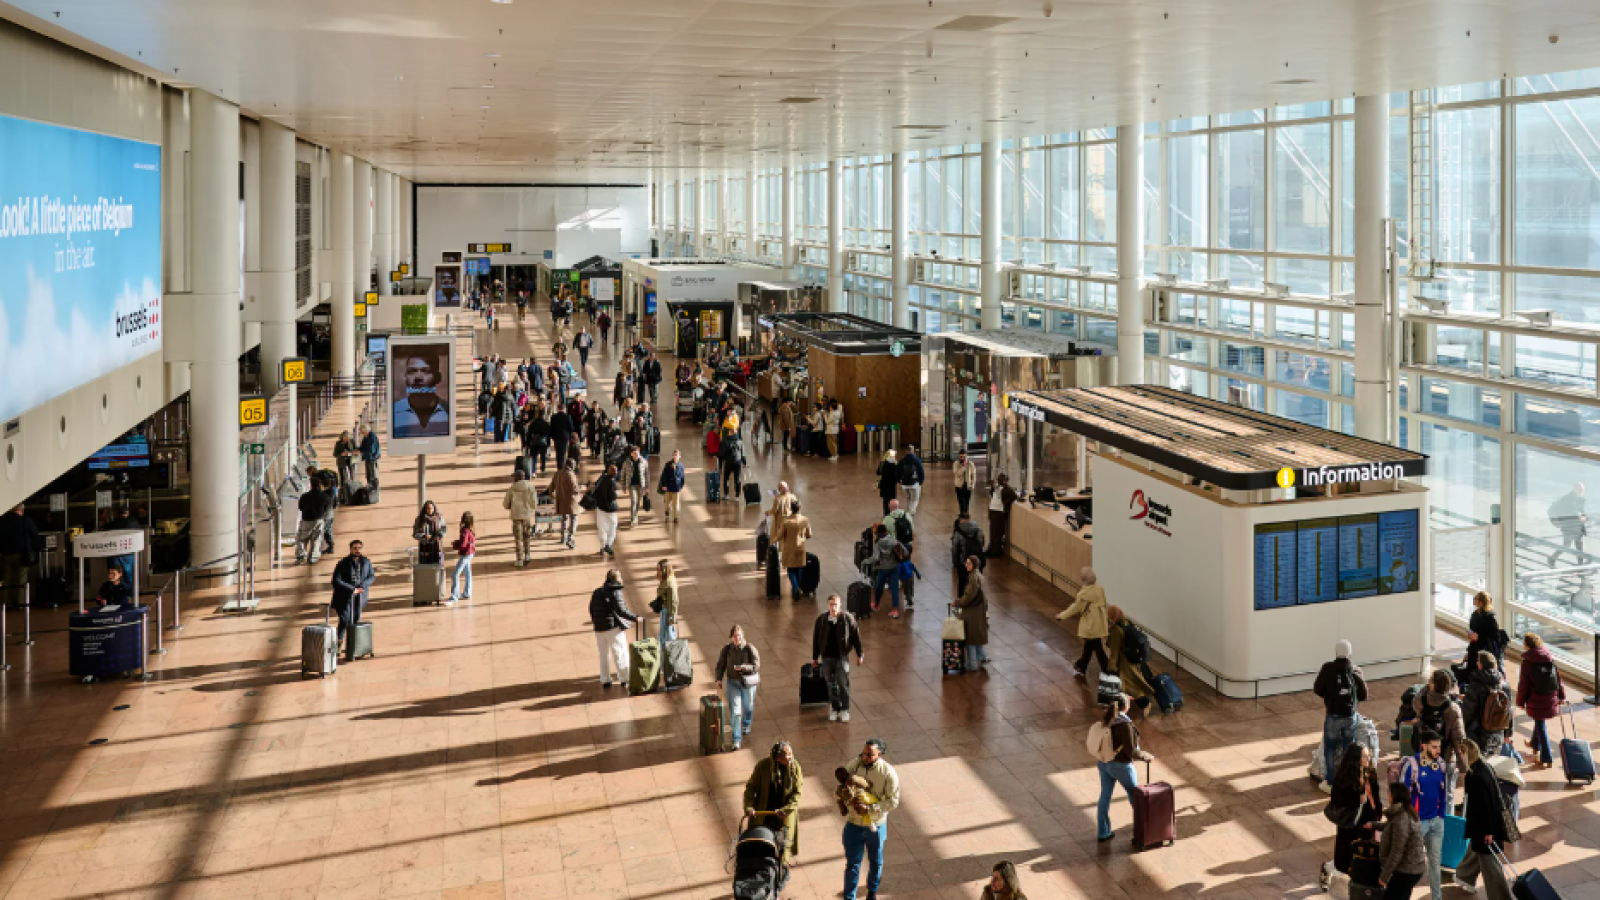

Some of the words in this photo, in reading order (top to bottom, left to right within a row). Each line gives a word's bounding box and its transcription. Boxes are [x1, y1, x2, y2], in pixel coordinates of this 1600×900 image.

[31, 196, 39, 235] A
[41, 194, 66, 234] little
[67, 195, 92, 240] piece
[93, 195, 104, 231] of
[103, 195, 133, 236] Belgium
[55, 243, 64, 272] in
[66, 241, 81, 270] the
[116, 303, 147, 338] brussels
[288, 368, 303, 380] 06
[243, 407, 263, 421] 05
[1303, 462, 1404, 486] Information
